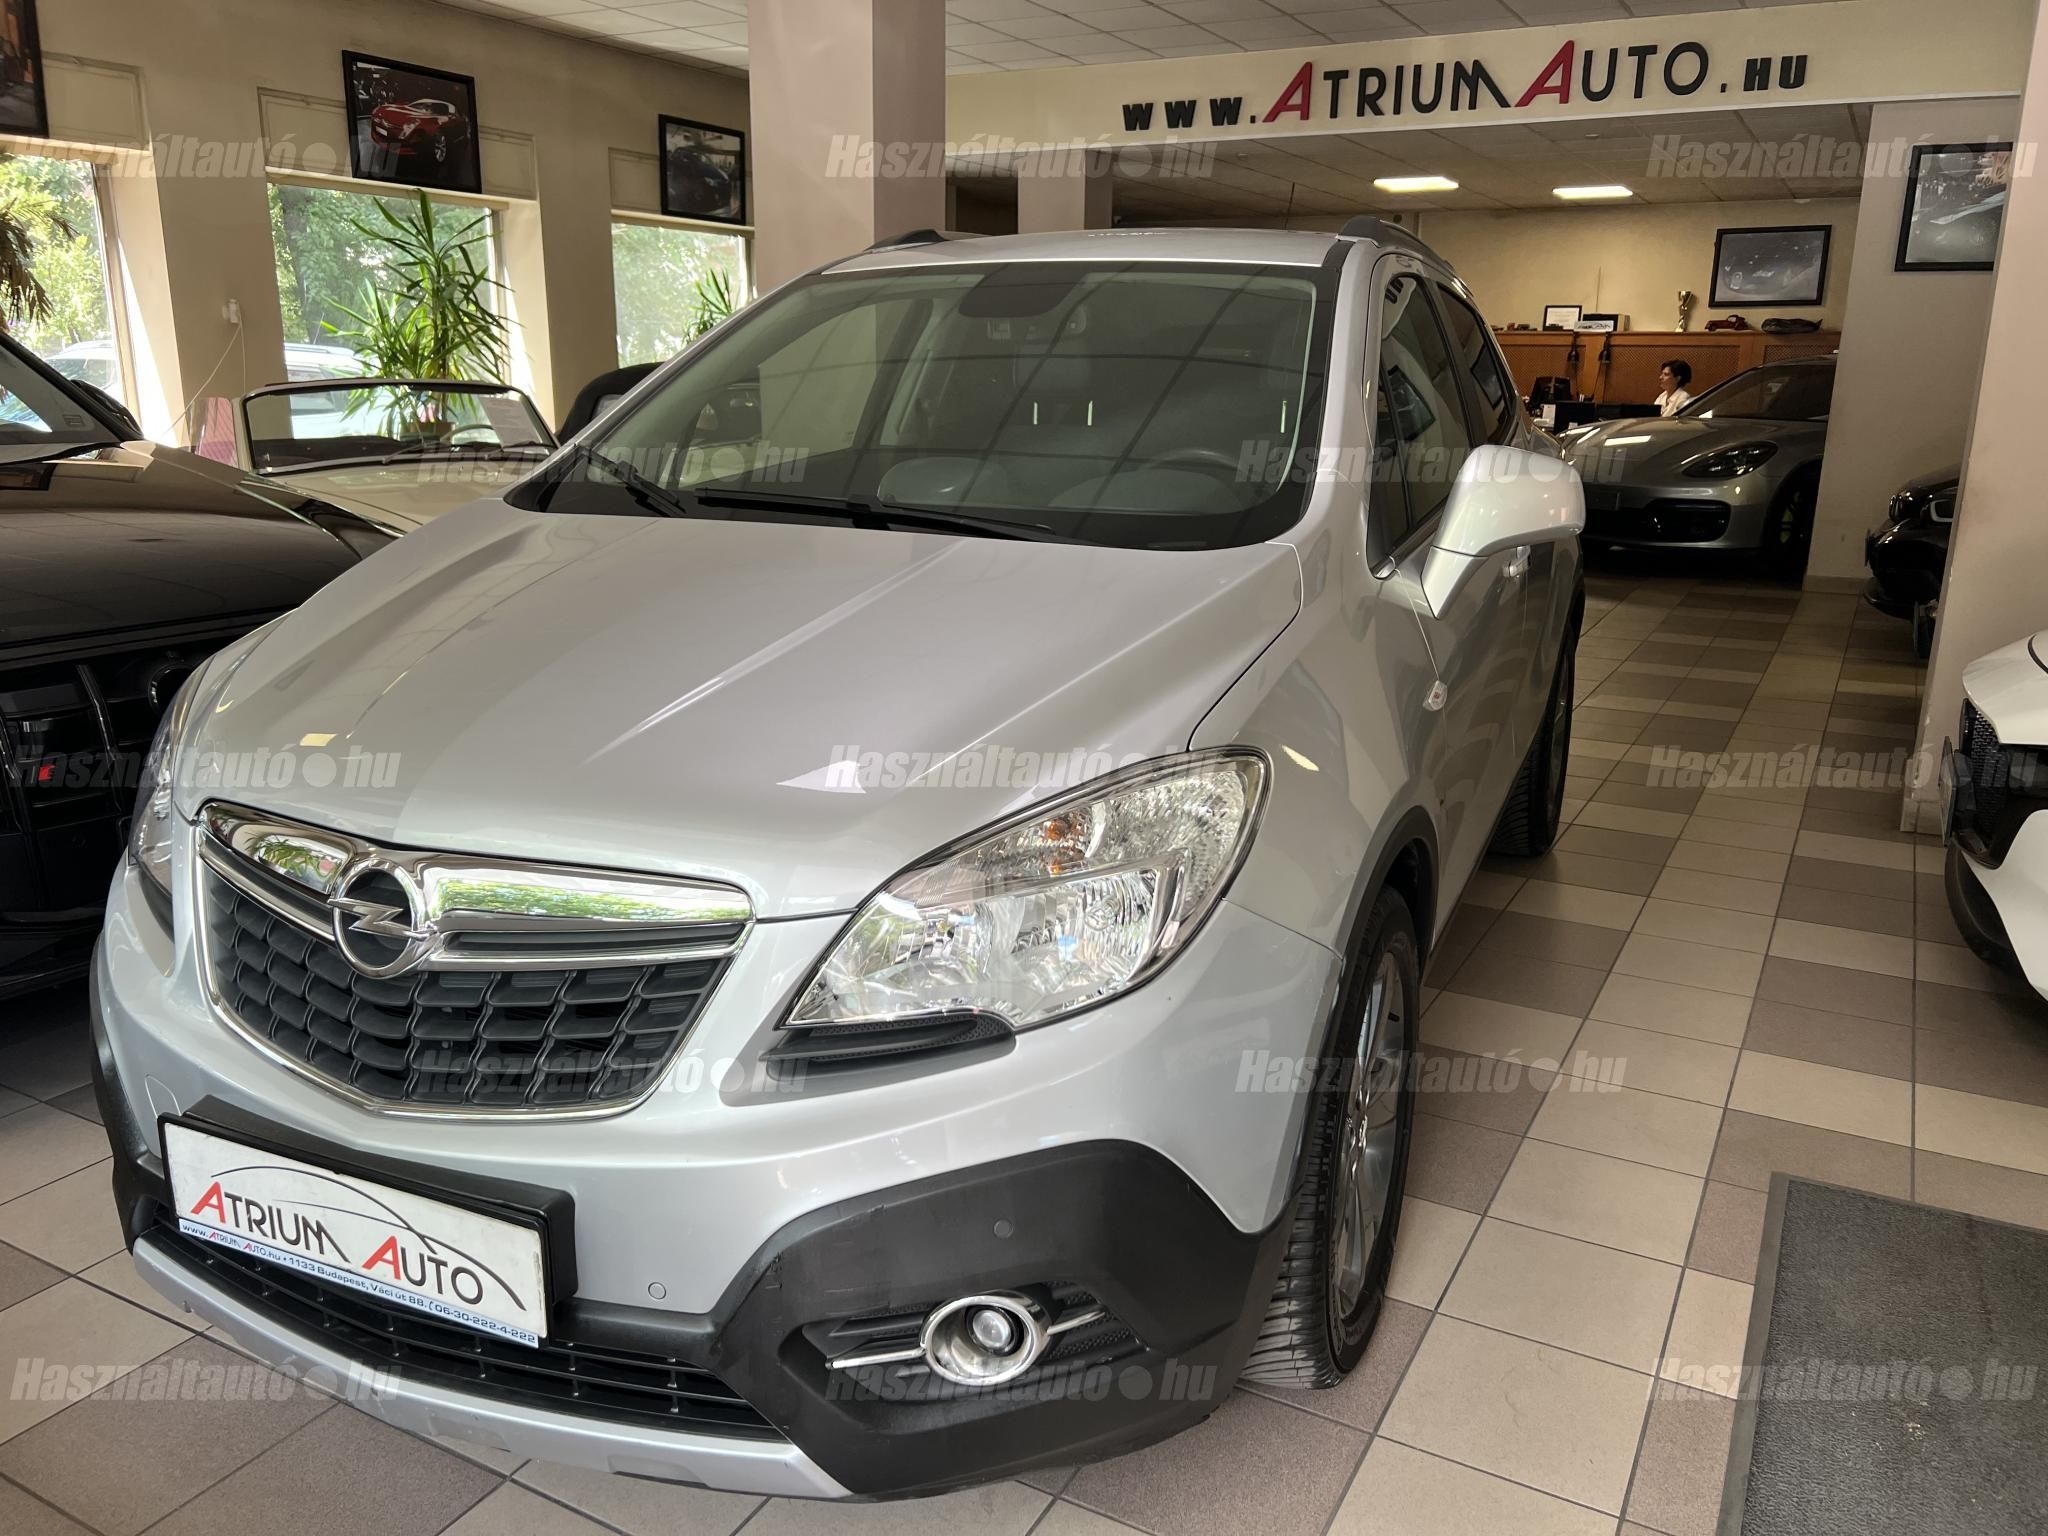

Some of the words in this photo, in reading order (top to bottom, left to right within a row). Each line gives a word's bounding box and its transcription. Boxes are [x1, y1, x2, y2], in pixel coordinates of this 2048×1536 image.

[191, 1181, 351, 1263] ATRIUM
[362, 1236, 484, 1305] AUTO
[289, 1257, 316, 1272] 1133
[317, 1266, 369, 1291] Budapest,
